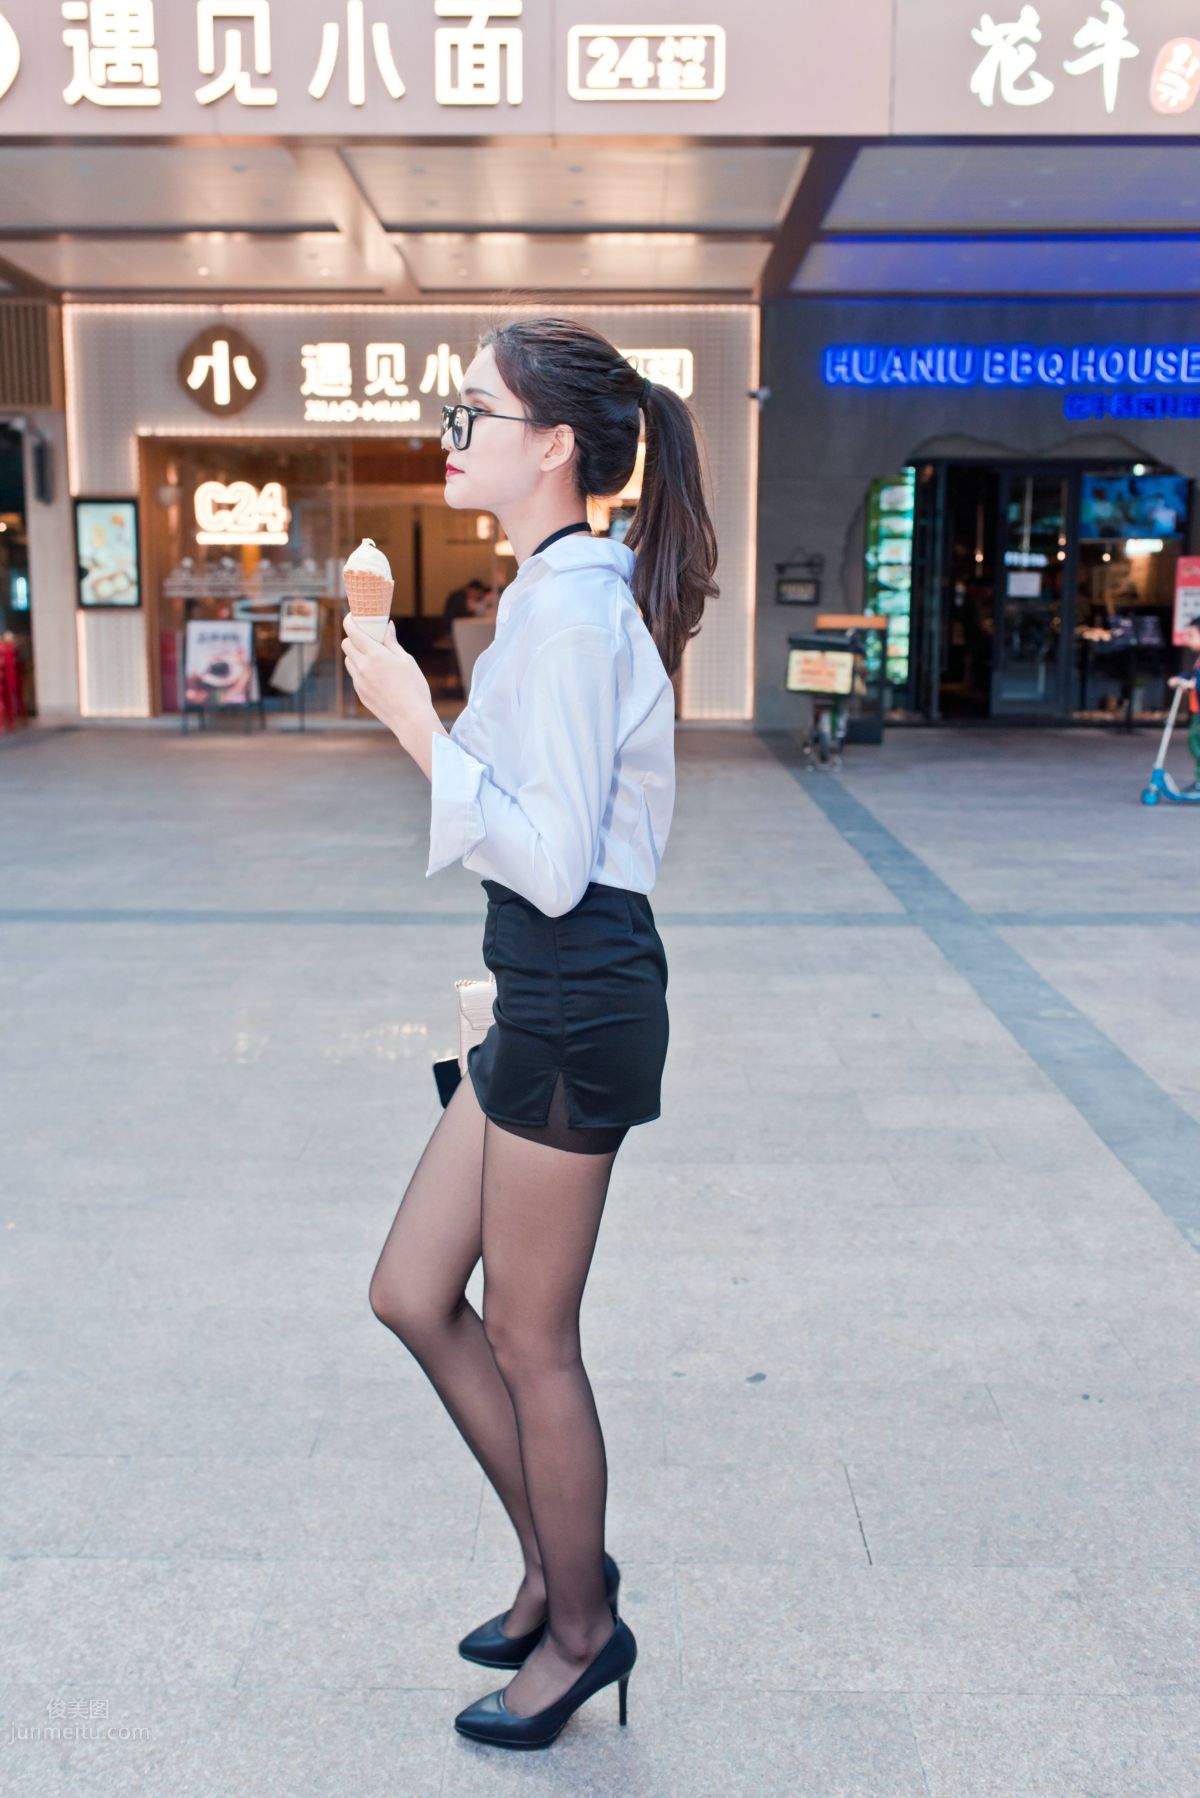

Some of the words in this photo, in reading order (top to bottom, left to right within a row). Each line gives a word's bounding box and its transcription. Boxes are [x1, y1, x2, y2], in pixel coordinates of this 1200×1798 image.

[62, 0, 523, 106] 遇见小面
[586, 36, 655, 89] 24
[970, 0, 1140, 113] 花牛
[825, 348, 974, 384] HUANIU
[1070, 347, 1200, 385] HOUSE
